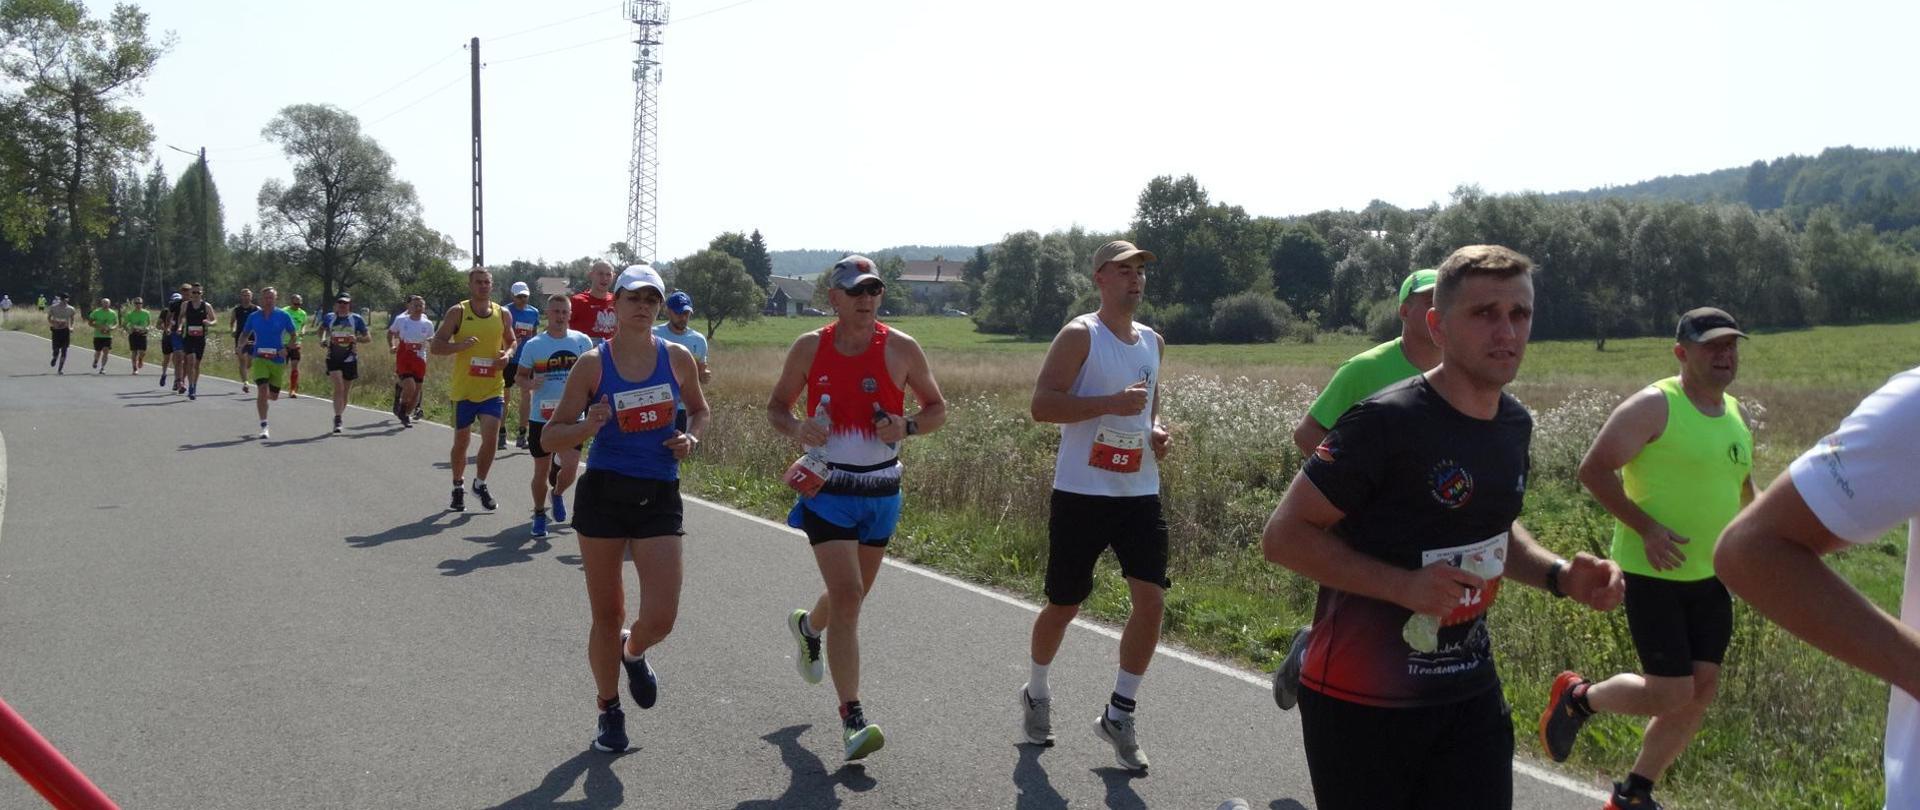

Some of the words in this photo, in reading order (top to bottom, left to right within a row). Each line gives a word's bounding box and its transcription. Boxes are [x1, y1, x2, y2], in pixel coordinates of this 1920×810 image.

[639, 410, 658, 423] 38
[1111, 453, 1129, 465] 85
[792, 470, 807, 482] 77
[1459, 587, 1481, 607] 42
